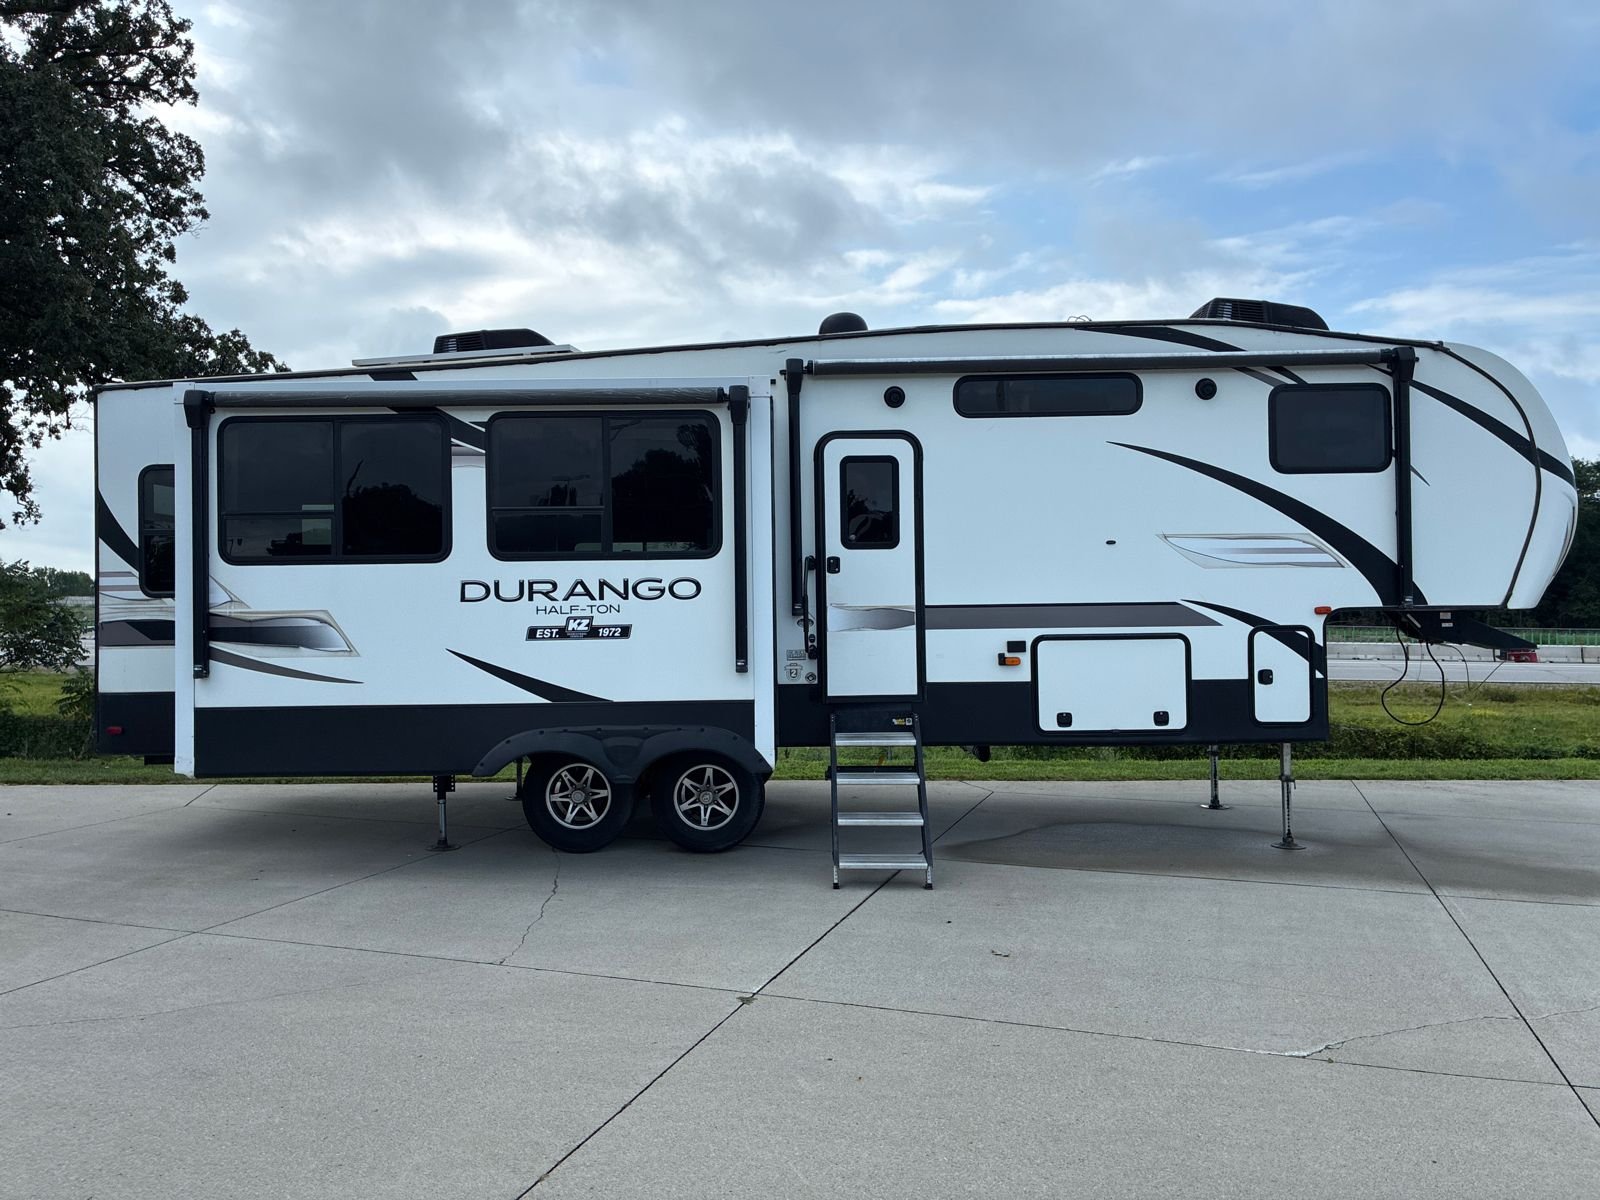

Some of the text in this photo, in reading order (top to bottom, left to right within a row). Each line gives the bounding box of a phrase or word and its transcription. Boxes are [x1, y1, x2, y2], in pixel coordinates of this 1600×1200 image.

[459, 577, 701, 602] DURANGO
[536, 604, 620, 615] HALF-TON
[567, 619, 590, 631] KZ
[536, 628, 559, 638] EST.
[598, 627, 622, 637] 1972
